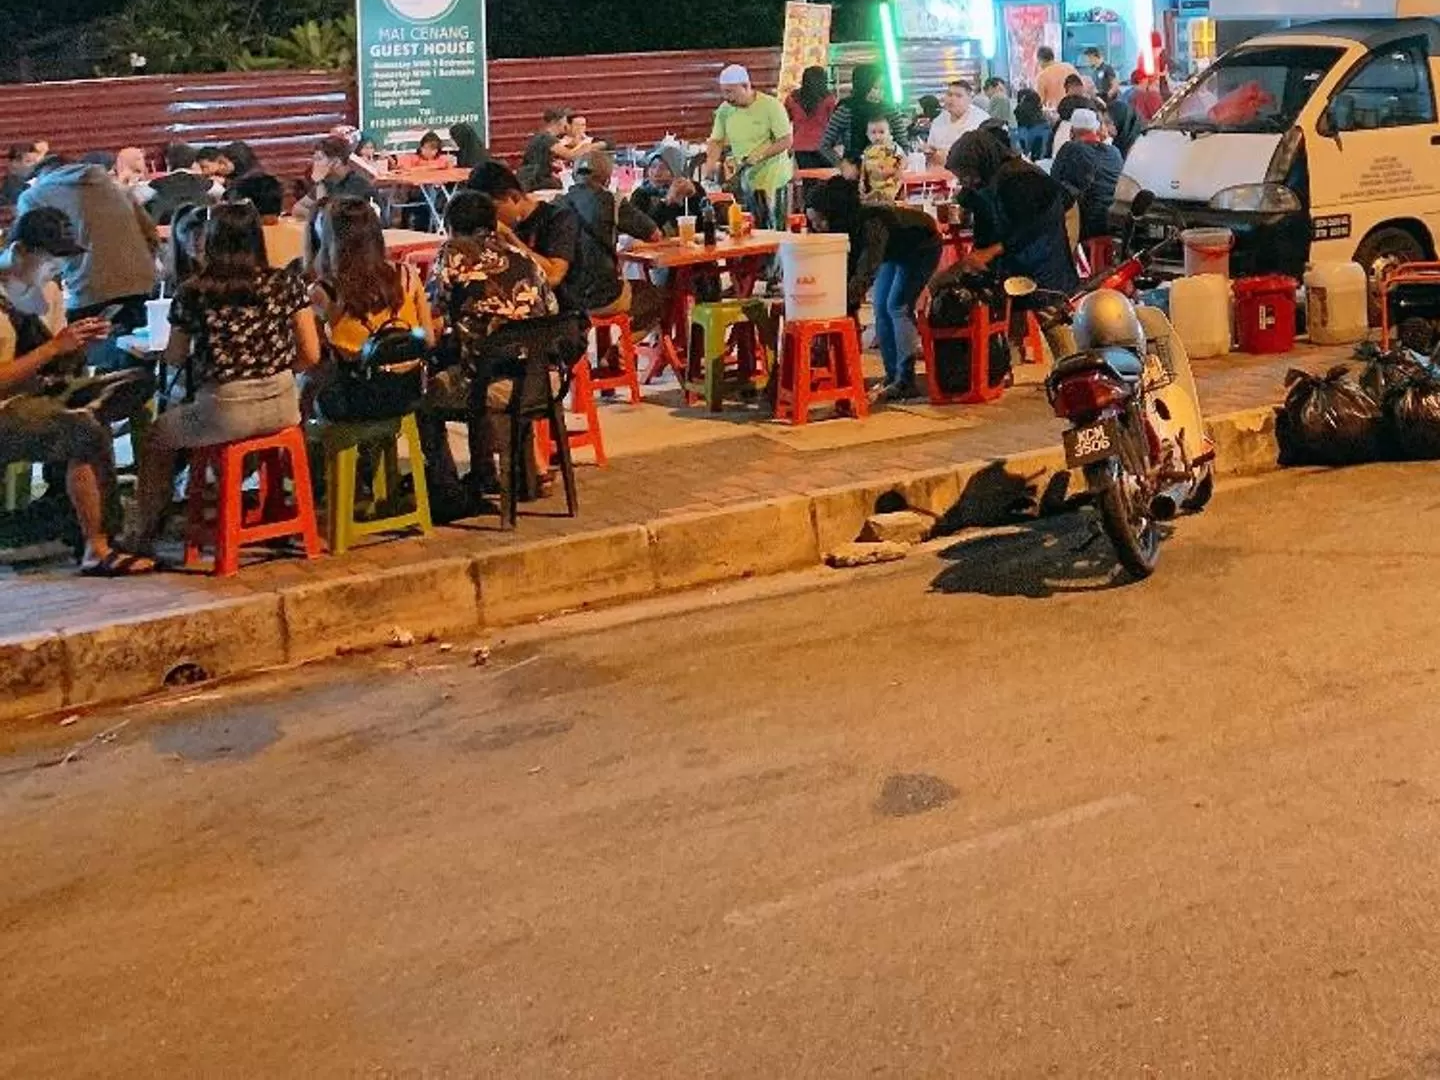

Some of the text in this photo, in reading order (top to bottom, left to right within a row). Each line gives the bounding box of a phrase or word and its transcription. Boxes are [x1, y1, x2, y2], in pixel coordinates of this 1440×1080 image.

[410, 26, 470, 40] CENANG
[370, 41, 475, 57] GUEST HOUSE
[1075, 437, 1111, 457] 3506
